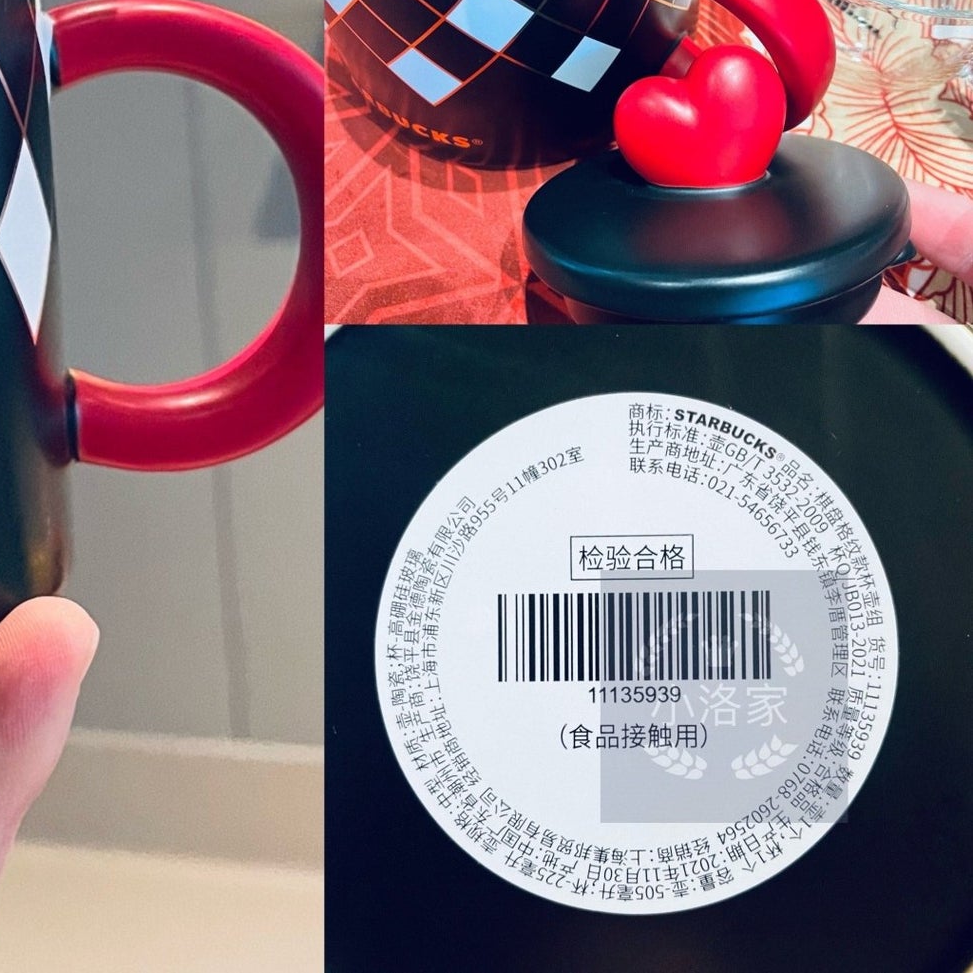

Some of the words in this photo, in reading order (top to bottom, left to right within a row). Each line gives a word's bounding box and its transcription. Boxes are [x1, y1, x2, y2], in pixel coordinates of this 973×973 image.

[578, 544, 685, 571] 检验合格
[588, 686, 681, 703] 11135939
[560, 723, 707, 750] (食品接触用)
